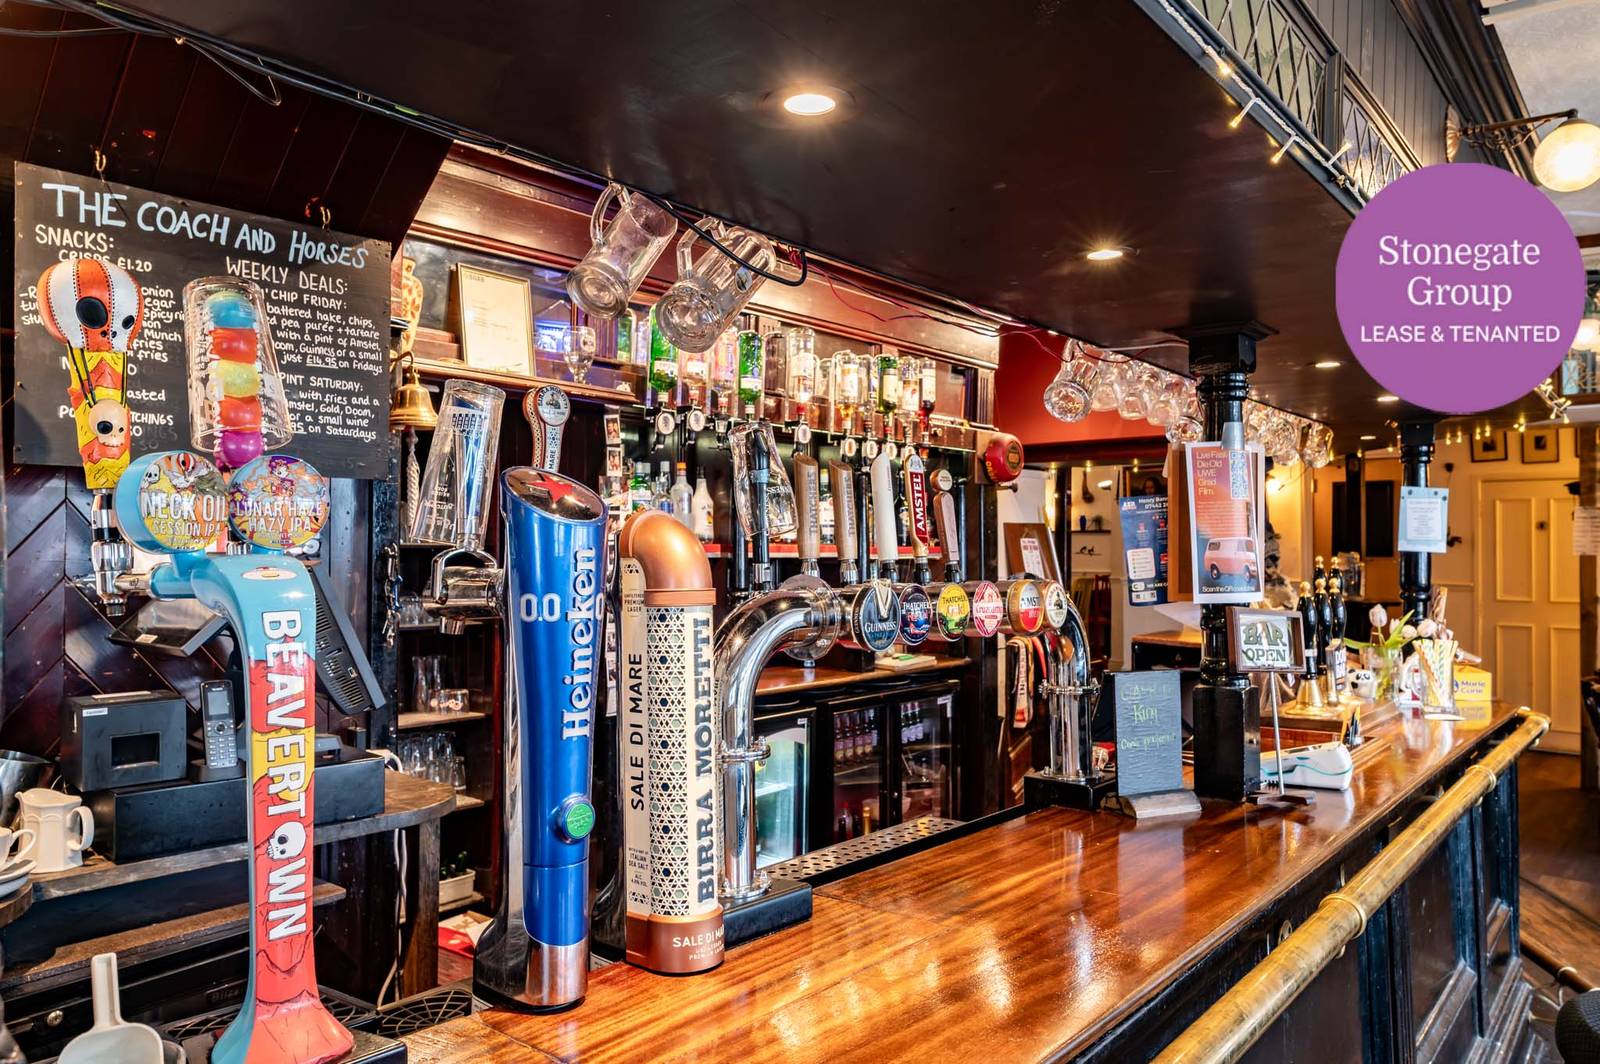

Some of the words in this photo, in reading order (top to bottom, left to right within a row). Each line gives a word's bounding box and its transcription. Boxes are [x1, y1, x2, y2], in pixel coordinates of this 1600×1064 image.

[42, 183, 127, 227] THE
[137, 202, 230, 246] COACH
[234, 223, 276, 254] AND
[288, 230, 369, 269] HORSES
[35, 224, 114, 252] SNACKS:
[226, 256, 289, 284] WEEKLY
[299, 270, 348, 295] DEALS:
[141, 285, 173, 299] onion
[271, 289, 298, 303] CHIP
[303, 294, 347, 310] FRIDAY:
[266, 302, 312, 319] battered
[317, 310, 346, 325] hake,
[281, 320, 300, 330] pea
[144, 329, 182, 342] Munch
[276, 330, 301, 341] with
[314, 334, 334, 345] pint
[137, 349, 168, 362] fries
[281, 352, 303, 364] just
[339, 360, 350, 369] on
[359, 351, 382, 362] small
[310, 376, 363, 392] SATURDAY:
[127, 389, 166, 402] asted
[299, 390, 322, 400] with
[324, 393, 347, 405] fries
[352, 395, 371, 406] and
[318, 415, 342, 426] small
[346, 417, 369, 427] wine
[308, 424, 321, 434] on
[326, 425, 377, 443] Saturdays
[143, 491, 196, 522] NECK
[203, 493, 229, 523] OIL
[236, 499, 283, 518] LUNAR
[288, 498, 323, 517] HAZE
[913, 474, 926, 532] AMSTEL
[153, 520, 201, 537] SESSION
[204, 524, 221, 536] IPA
[248, 517, 285, 533] HAZY
[290, 517, 311, 533] IPA
[520, 593, 561, 622] 0.0
[864, 619, 897, 633] GUINNESS
[1243, 622, 1288, 647] BAR
[561, 546, 596, 741] Heineken
[1243, 648, 1287, 662] OPEN
[629, 653, 643, 714] MARE
[693, 617, 714, 778] MORETTI
[630, 723, 644, 746] DI
[630, 755, 645, 811] SALE
[696, 789, 715, 903] BIRRA
[672, 934, 704, 948] SALE
[705, 931, 715, 944] DI
